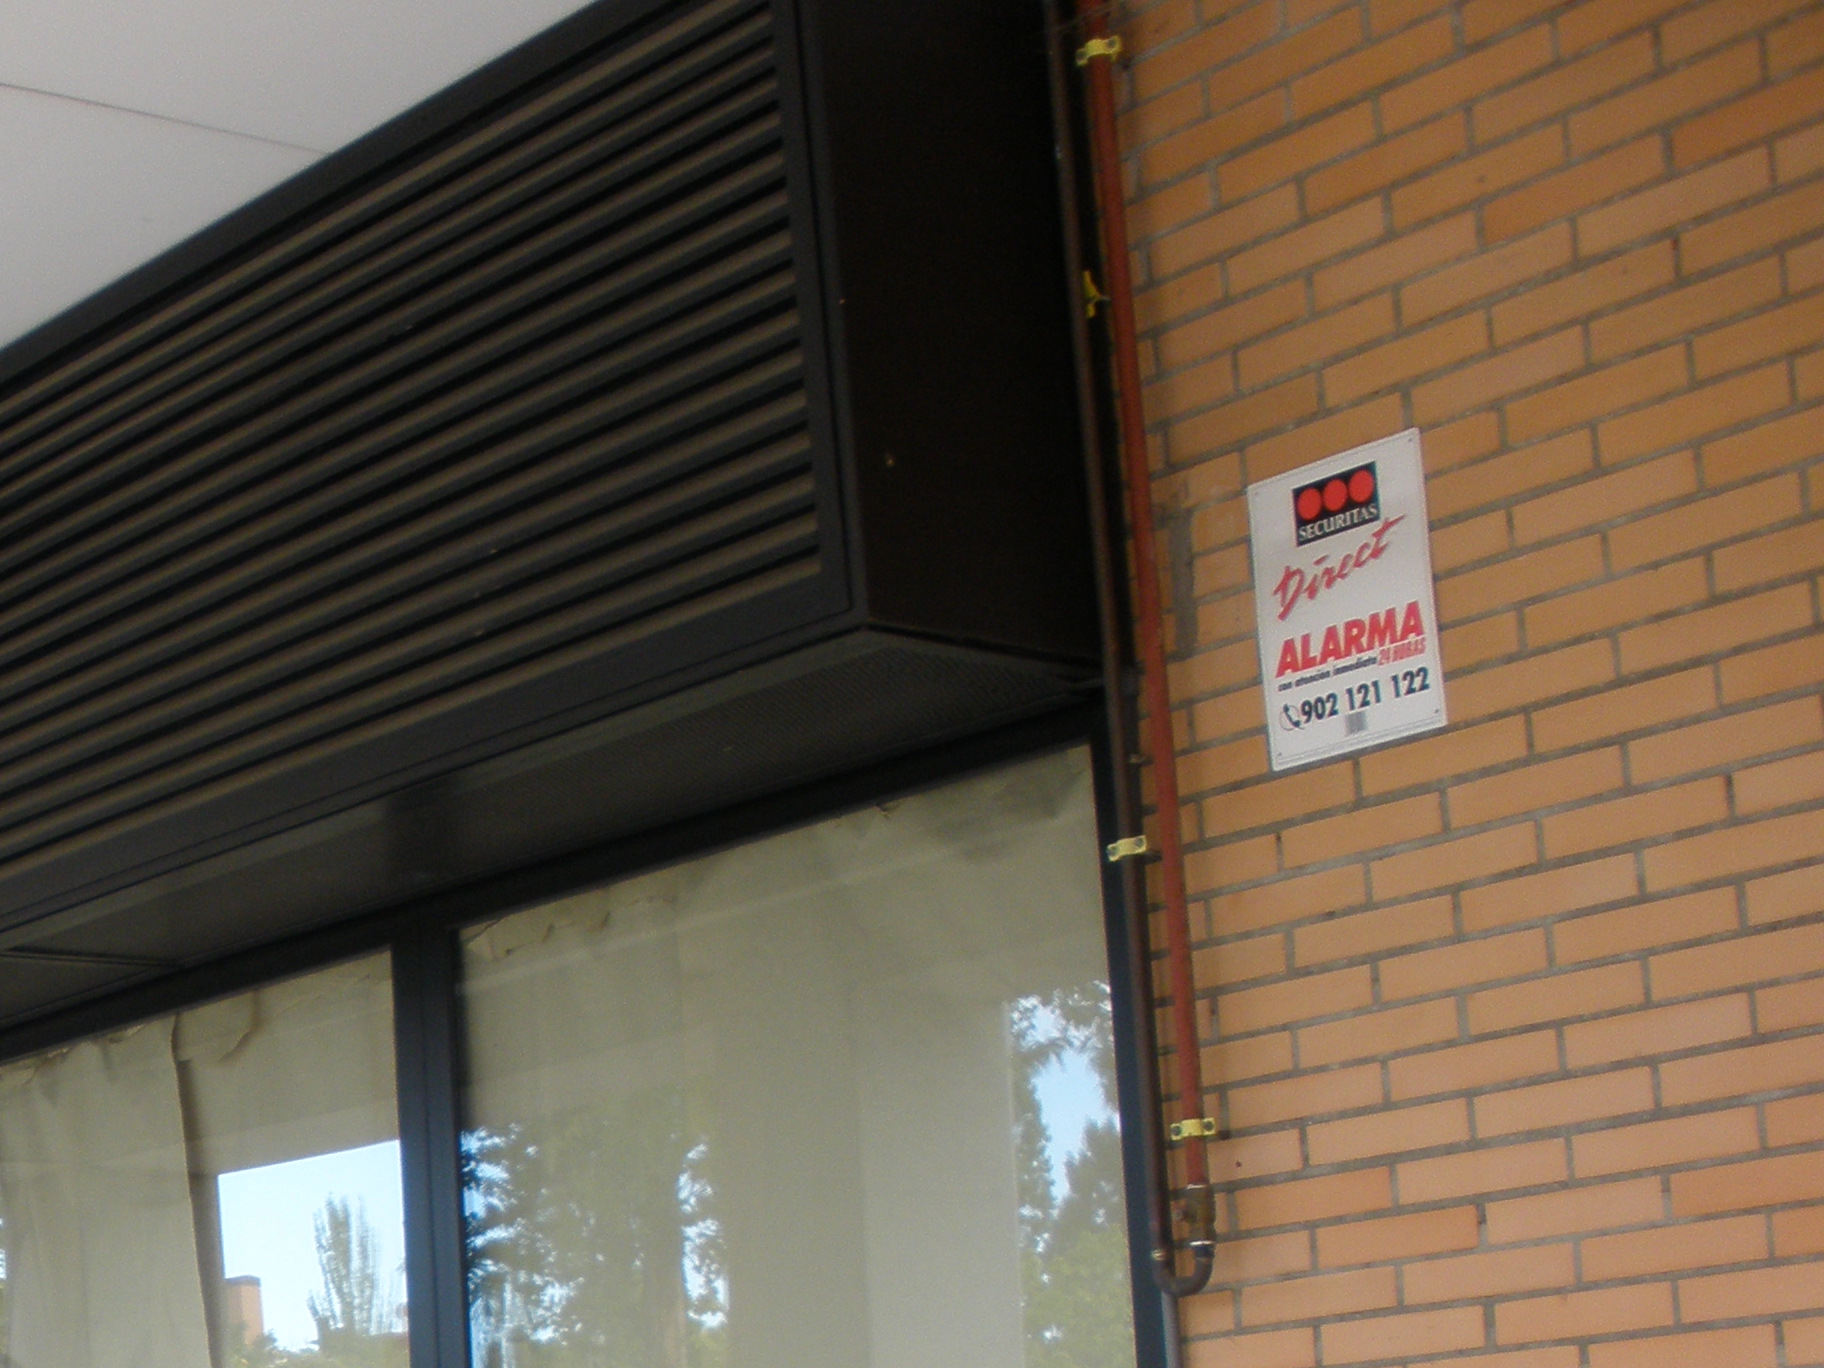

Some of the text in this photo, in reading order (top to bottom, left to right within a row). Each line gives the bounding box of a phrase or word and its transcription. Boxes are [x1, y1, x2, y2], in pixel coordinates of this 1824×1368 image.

[1298, 503, 1378, 541] SECURITAS
[1273, 514, 1406, 621] Direct
[1275, 600, 1425, 678] ALARMA
[1301, 666, 1430, 725] 902 121 122
